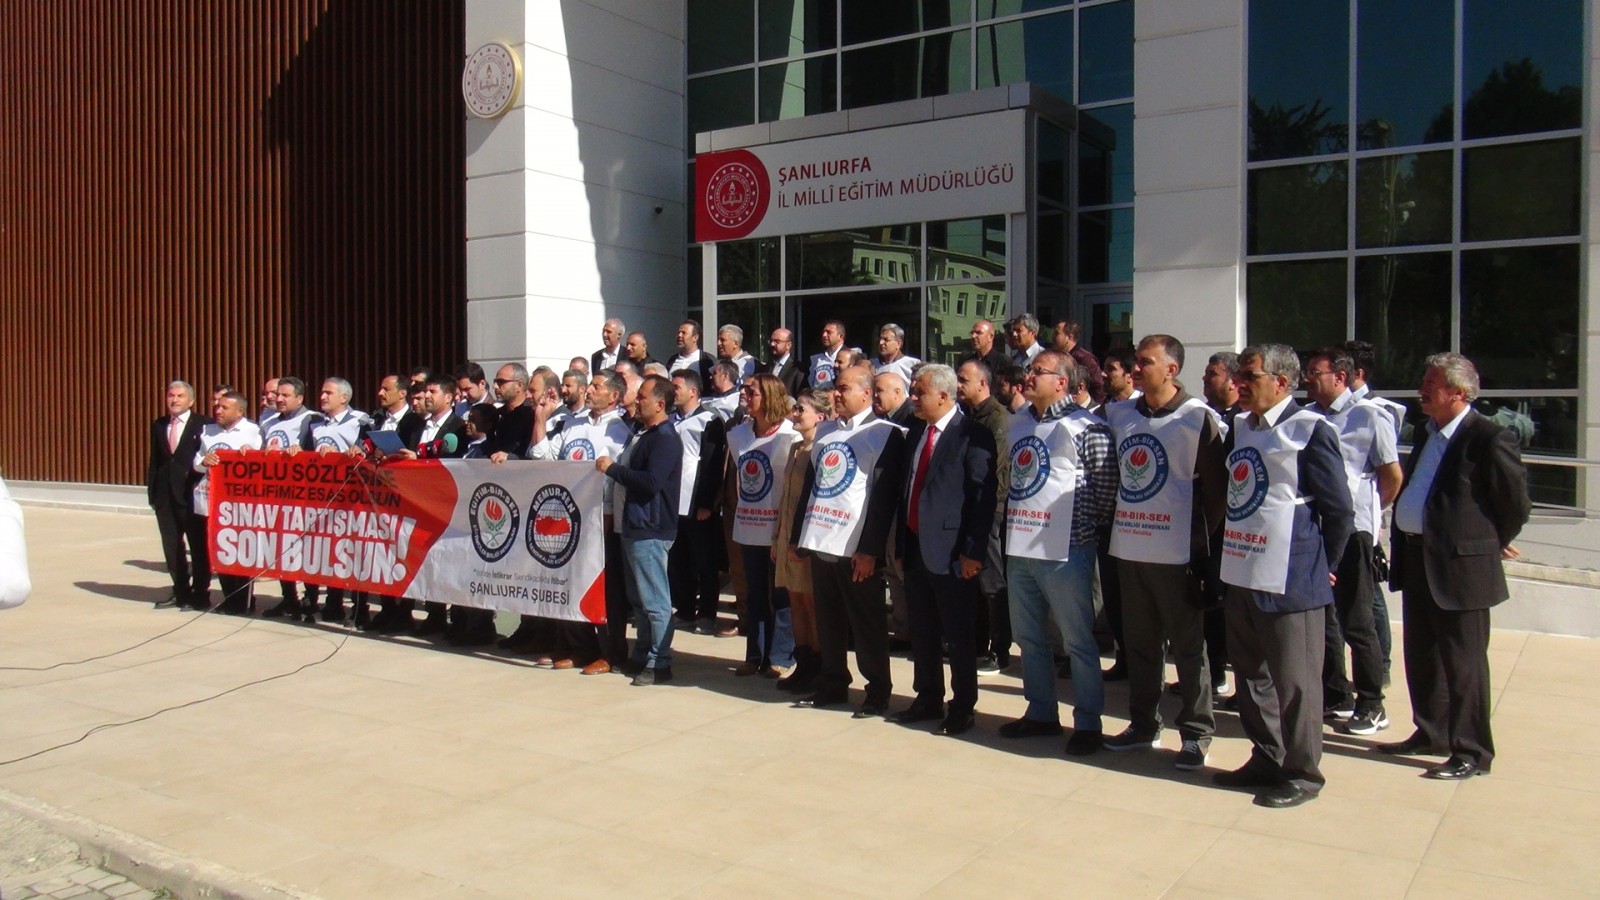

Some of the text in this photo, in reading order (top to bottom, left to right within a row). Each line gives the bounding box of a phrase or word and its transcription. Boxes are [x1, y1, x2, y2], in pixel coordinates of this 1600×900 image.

[778, 156, 872, 187] ŞANLIURFA
[778, 190, 790, 209] İL
[839, 179, 894, 202] EĞİTİM
[900, 163, 1014, 195] MÜDÜRLÜĞÜ
[222, 460, 288, 481] TOPLU
[309, 487, 346, 503] ESAS
[532, 487, 576, 513] MEMUR-SEN
[218, 501, 399, 541] SINAV TARTIŞMASI
[216, 528, 278, 570] SON
[469, 581, 570, 606] ŞANLIURFA ŞUBESİ
